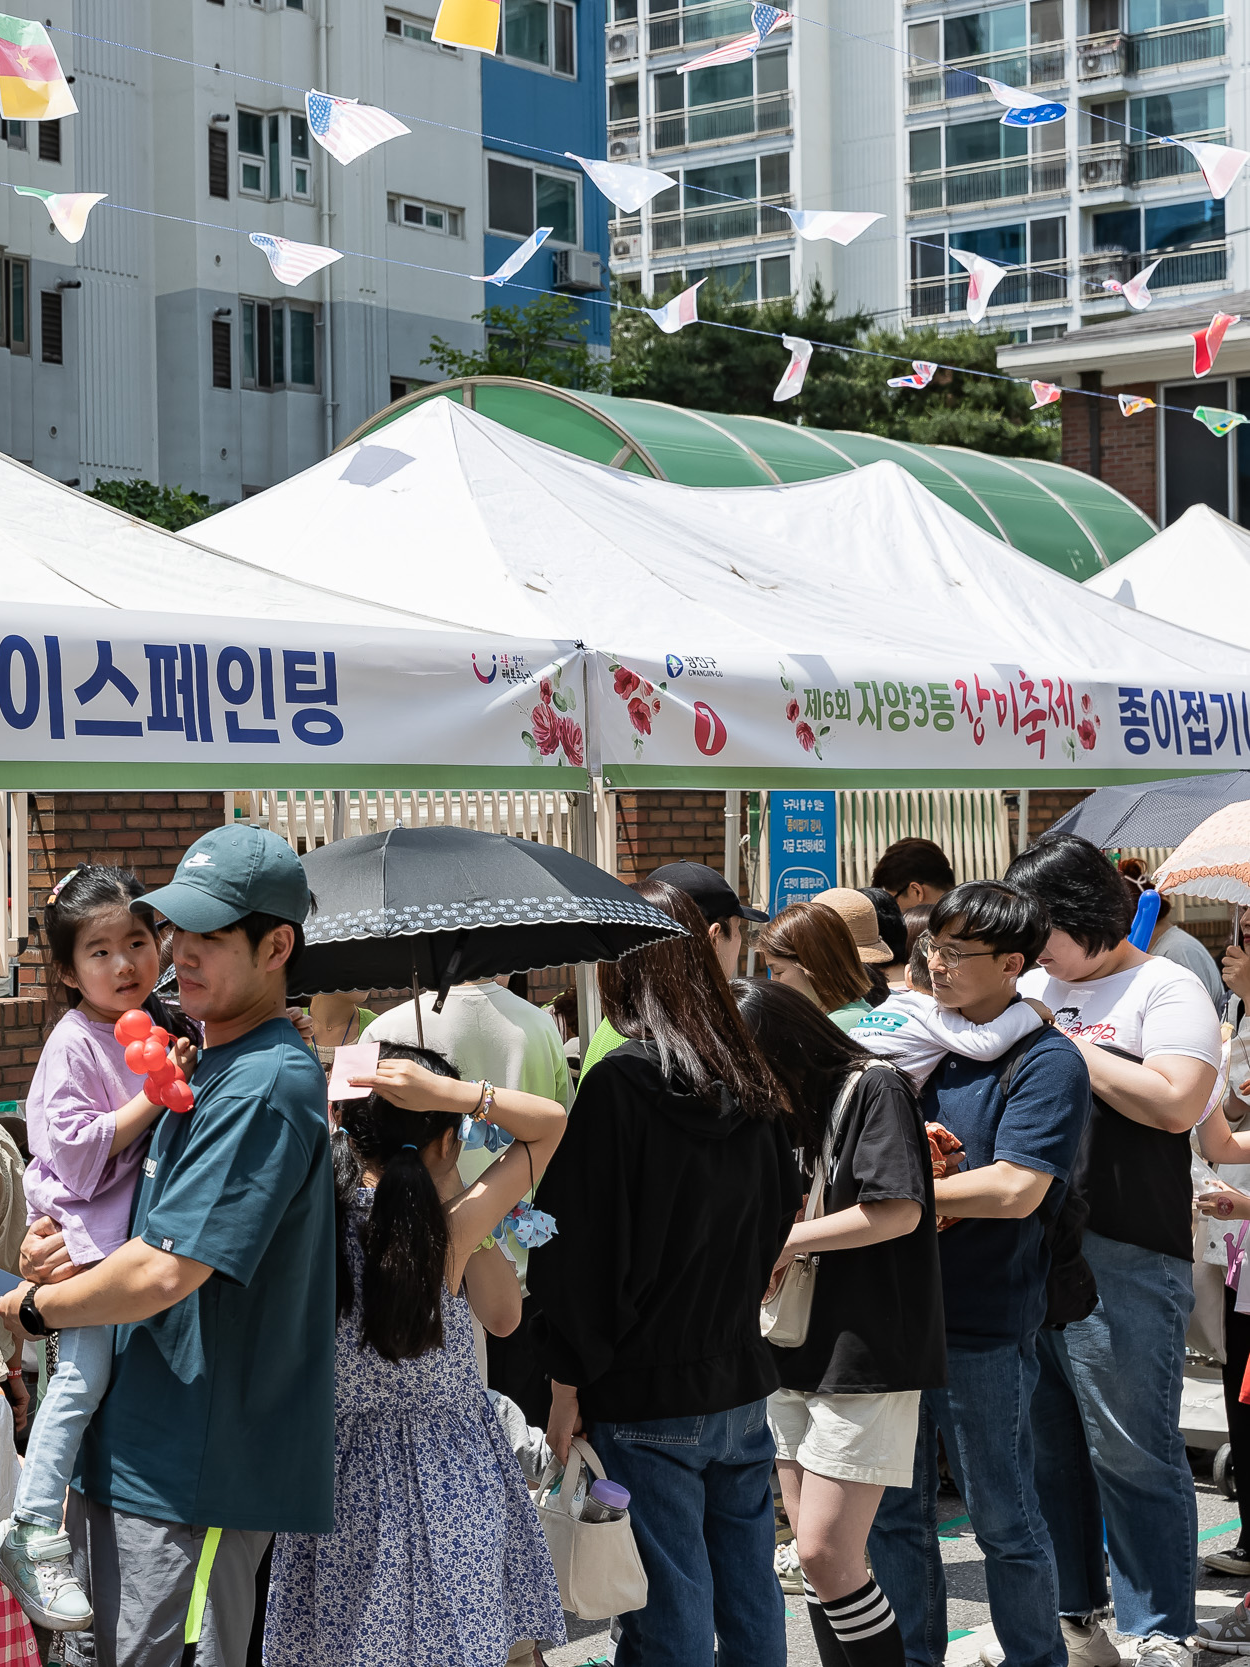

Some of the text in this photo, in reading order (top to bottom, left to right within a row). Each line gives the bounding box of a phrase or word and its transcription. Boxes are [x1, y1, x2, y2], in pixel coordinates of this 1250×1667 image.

[803, 670, 1076, 760] 제6회 자양3동 장미축제
[783, 799, 799, 811] 누구나
[807, 799, 813, 811] 수
[813, 799, 825, 812] 있는
[782, 839, 794, 853] 지금
